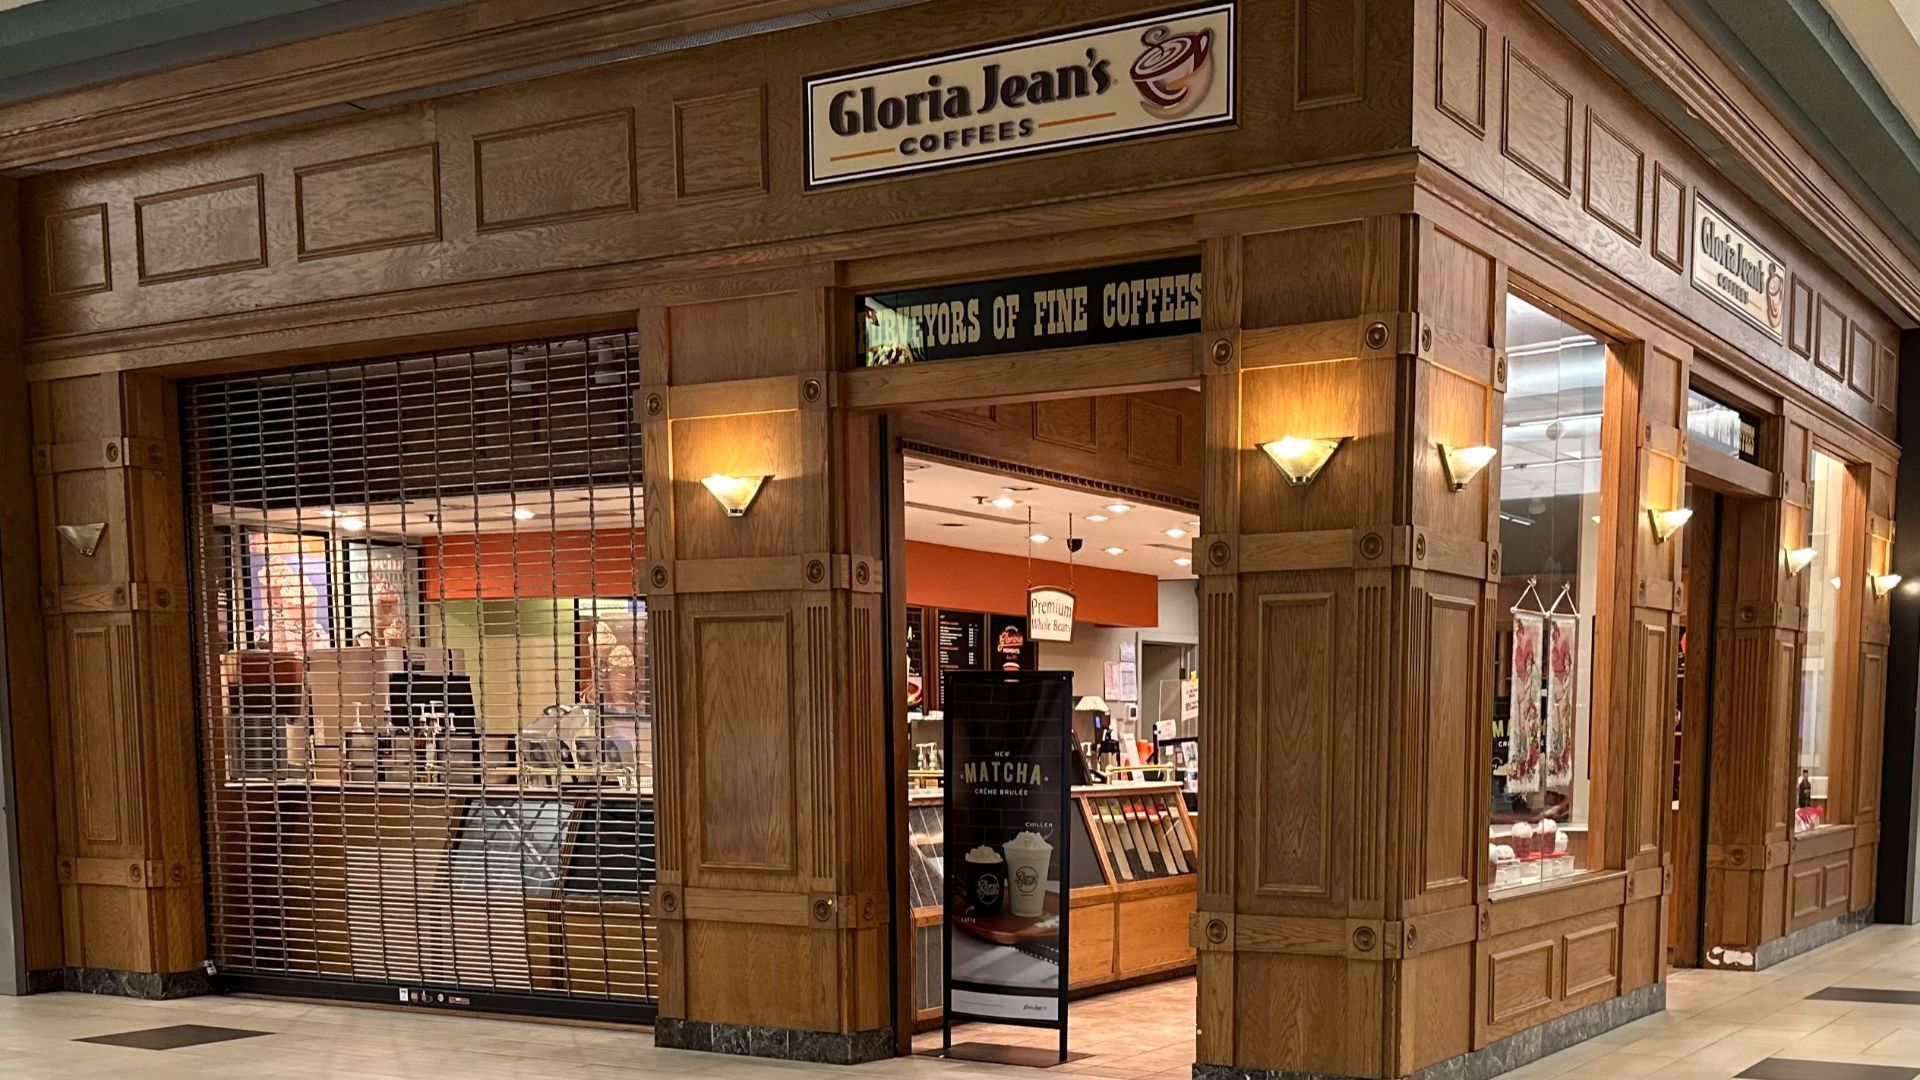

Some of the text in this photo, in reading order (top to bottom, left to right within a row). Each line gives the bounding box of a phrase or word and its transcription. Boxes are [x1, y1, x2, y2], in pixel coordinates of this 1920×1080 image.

[828, 47, 1112, 137] Gloria Jean's
[898, 118, 1034, 156] COFFEES
[1702, 215, 1764, 294] Gloria Jean's
[1717, 272, 1749, 305] COFFEES
[993, 293, 1020, 340] OF
[1033, 286, 1088, 336] FINE
[1103, 272, 1202, 328] COFFEES
[1031, 598, 1072, 619] Premium
[1031, 617, 1051, 631] Whole
[964, 760, 1042, 785] MATCHA
[1024, 821, 1053, 829] CHILLER
